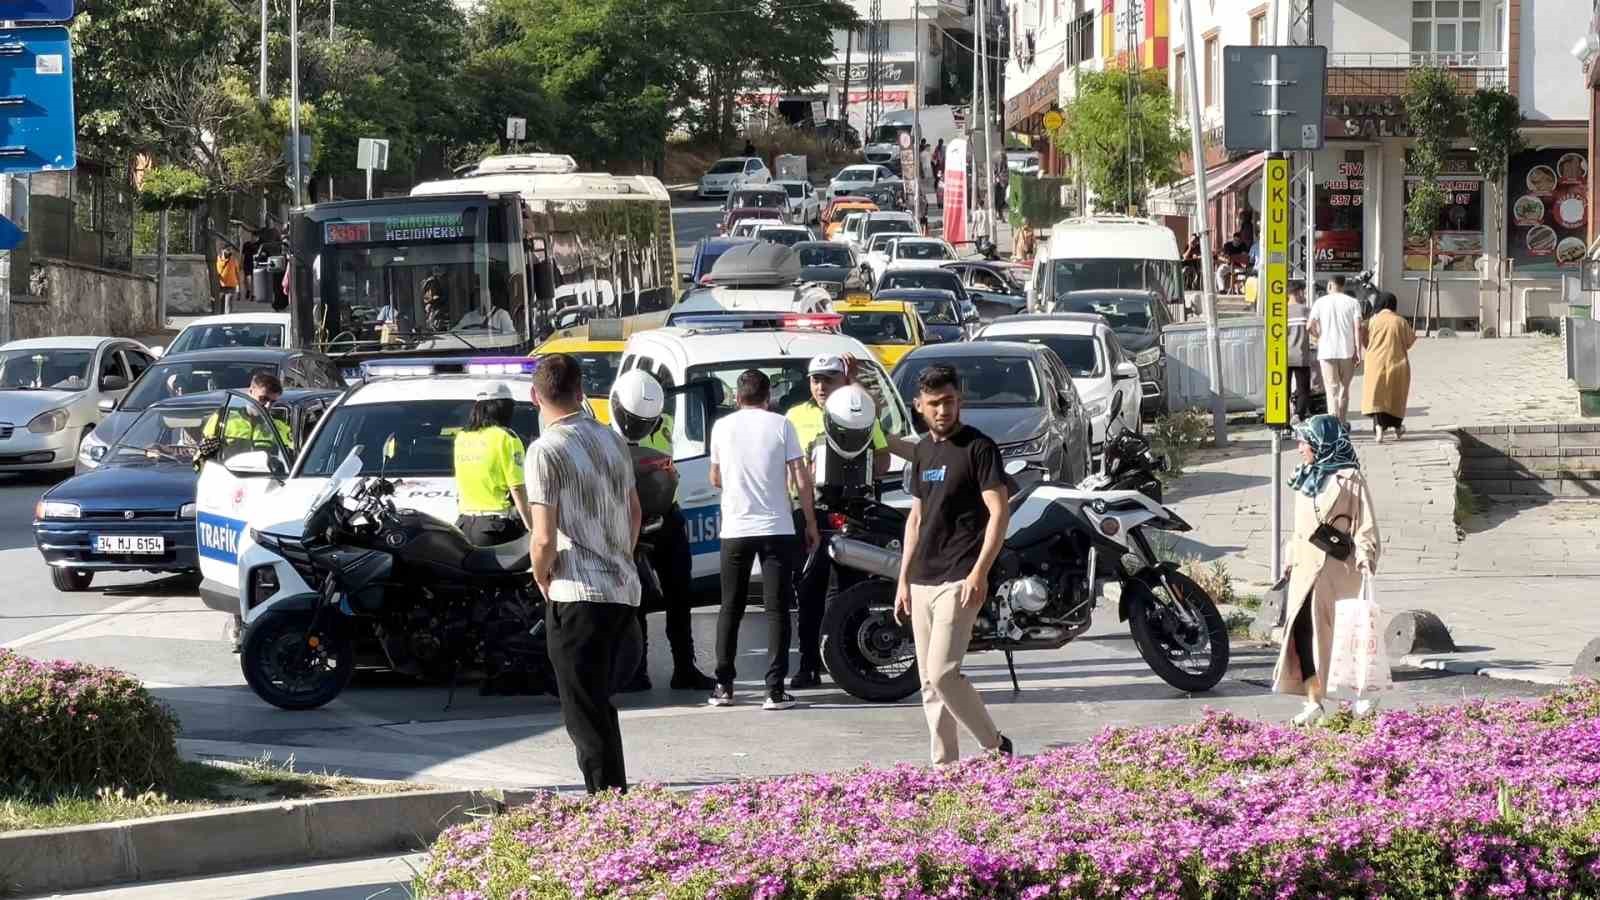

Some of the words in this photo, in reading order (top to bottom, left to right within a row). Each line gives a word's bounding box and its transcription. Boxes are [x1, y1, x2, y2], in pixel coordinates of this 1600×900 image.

[1272, 165, 1285, 245] OKUL
[1302, 247, 1334, 261] SVAS
[1271, 280, 1284, 411] GEÇİDİ
[408, 490, 457, 498] POL
[200, 521, 238, 555] TRAFİK
[685, 511, 720, 543] LİSİ
[99, 537, 111, 549] 34
[137, 537, 160, 550] 6154
